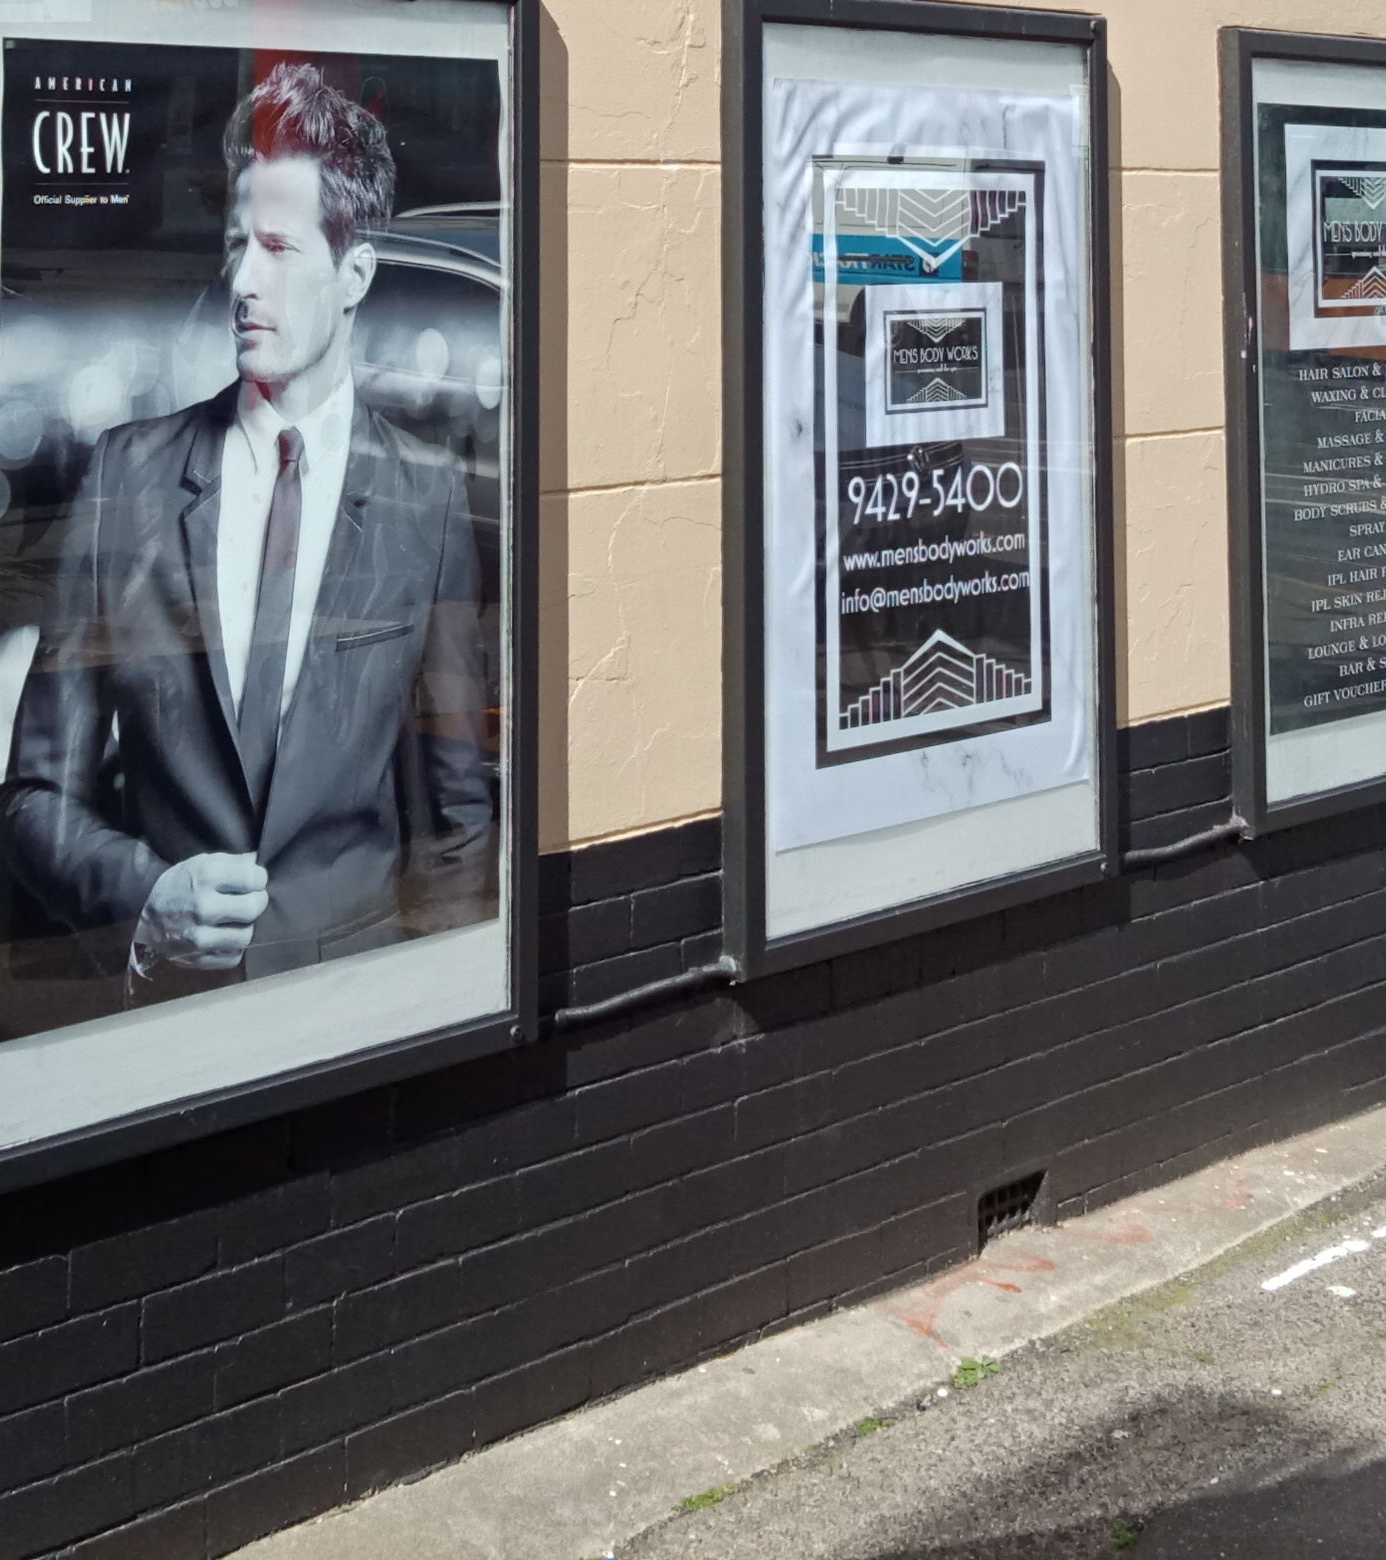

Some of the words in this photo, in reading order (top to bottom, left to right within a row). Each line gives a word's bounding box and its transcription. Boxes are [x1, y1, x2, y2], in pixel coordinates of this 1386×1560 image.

[34, 76, 132, 92] AMERICAN
[32, 111, 131, 174] CREW
[33, 194, 62, 205] Official
[99, 195, 109, 204] to
[1323, 221, 1352, 242] MENS
[1354, 221, 1382, 242] BODY
[894, 348, 918, 364] MENS
[920, 347, 944, 363] BODY
[946, 345, 978, 361] WORKS
[1299, 369, 1328, 381] HAIR
[1332, 365, 1368, 379] SALON
[1372, 363, 1381, 376] &
[1312, 389, 1356, 403] WAXING
[1360, 386, 1369, 399] &
[1317, 433, 1371, 449] MASSAGE
[1375, 429, 1384, 443] &
[1303, 456, 1371, 473] MANICURES
[1374, 452, 1383, 466] &
[847, 461, 1023, 524] 9429-5400
[1304, 481, 1345, 497] HYDRO
[1348, 478, 1370, 491] SPA
[1373, 474, 1382, 488] &
[1294, 505, 1326, 521] BODY
[1330, 501, 1377, 516] SCRUBS
[1349, 521, 1386, 537] SPRAY
[843, 531, 1025, 571] www.mensbodyworks.com
[1338, 548, 1361, 562] EAR
[1327, 573, 1346, 587] IPL
[1350, 568, 1378, 582] HAIR
[841, 569, 1030, 615] info@mensbodyworks.com
[1311, 598, 1331, 612] IPL
[1334, 593, 1362, 609] SKIN
[1330, 617, 1365, 632] INFRA
[1308, 641, 1355, 660] LOUNGE
[1359, 635, 1368, 650] &
[1339, 662, 1363, 677] BAR
[1366, 657, 1376, 672] &
[1303, 691, 1331, 708] GIFT
